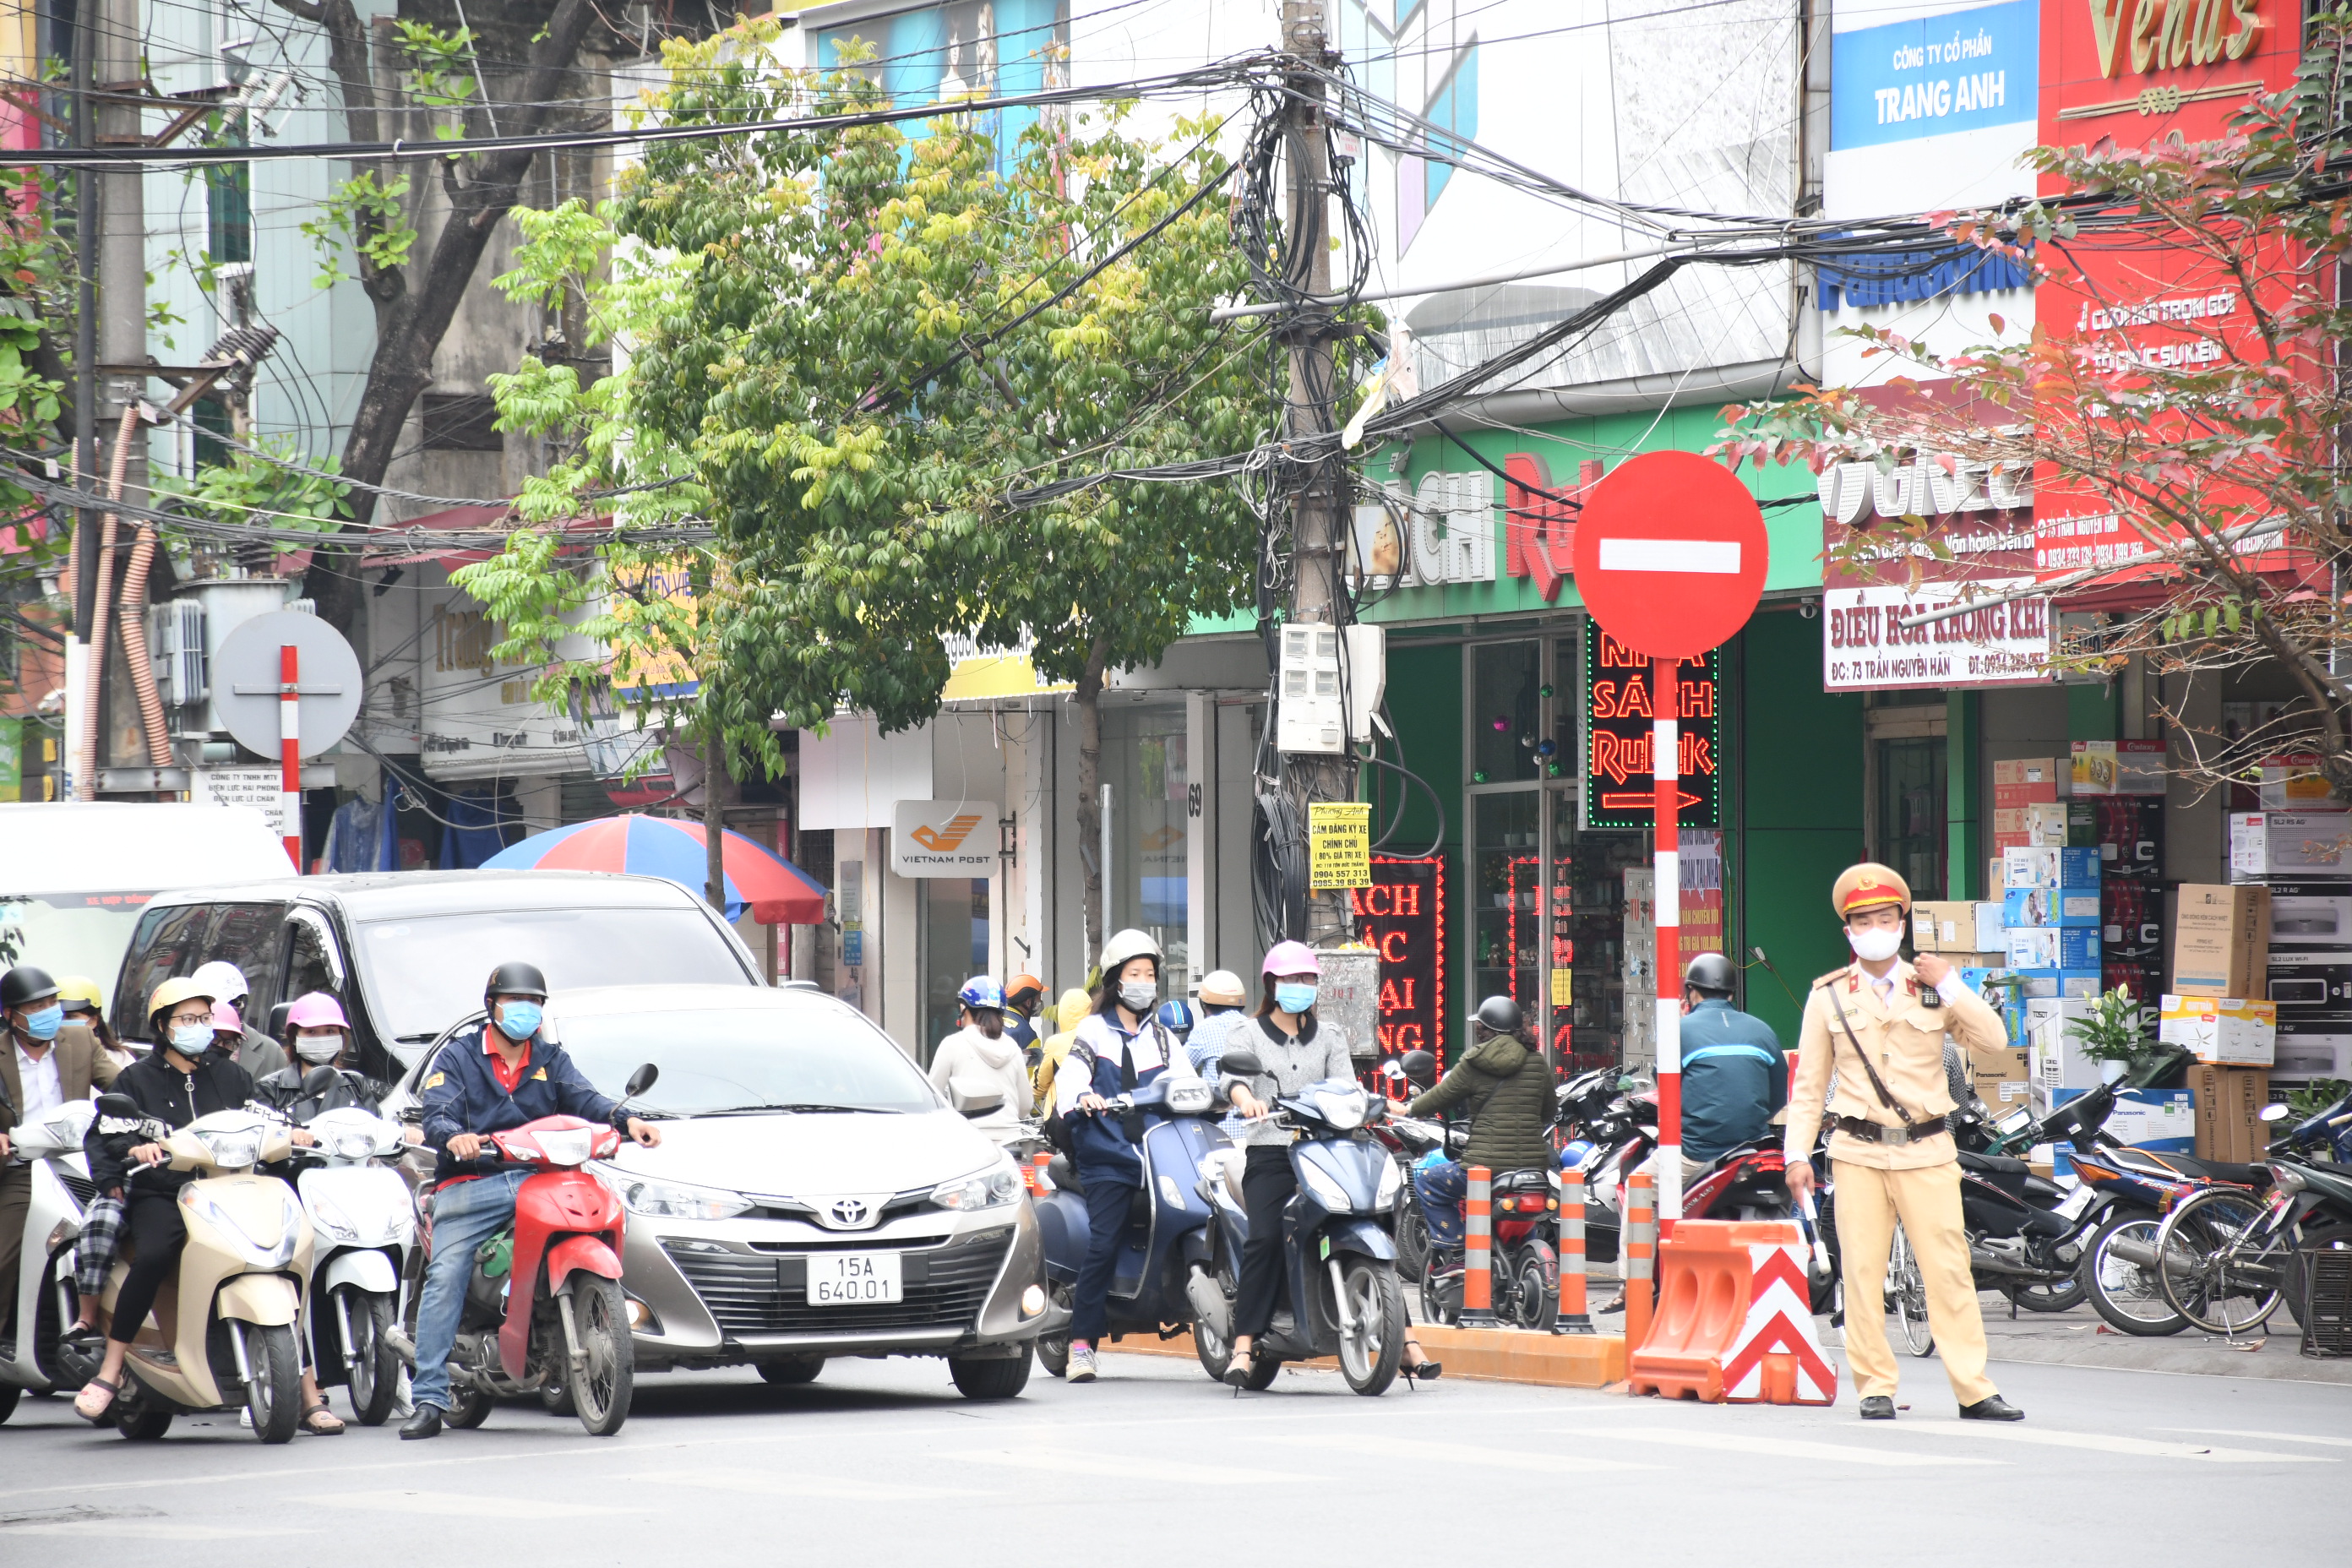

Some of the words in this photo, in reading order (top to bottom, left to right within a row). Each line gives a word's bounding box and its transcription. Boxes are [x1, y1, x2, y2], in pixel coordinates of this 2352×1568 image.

[1893, 45, 1925, 70] CÔNG
[1927, 44, 1942, 64] TY
[1944, 30, 1960, 63] CỔ
[1962, 27, 1992, 59] PHẦN
[1875, 80, 1951, 125] TRANG
[1954, 70, 2005, 113] ANH
[1831, 589, 1881, 648] ĐIỀU
[1832, 662, 1849, 681] ĐC:
[1852, 661, 1863, 680] 73
[1592, 674, 1713, 718] SÁH
[1189, 783, 1202, 818] 69
[1344, 806, 1364, 816] Anh
[1329, 823, 1347, 835] ĐĂNG
[1358, 825, 1367, 834] XE
[1322, 837, 1342, 849] CHÍNH
[1344, 835, 1358, 848] CHỦ
[1333, 849, 1343, 860] GIÁ
[1344, 851, 1353, 861] TRỊ
[1354, 851, 1362, 859] XE
[1314, 870, 1333, 879] 0904
[1336, 869, 1350, 878] 557
[1347, 878, 1357, 886] 86
[2137, 1178, 2180, 1193] Future
[838, 1257, 874, 1277] 15A
[819, 1279, 889, 1301] 640.01
